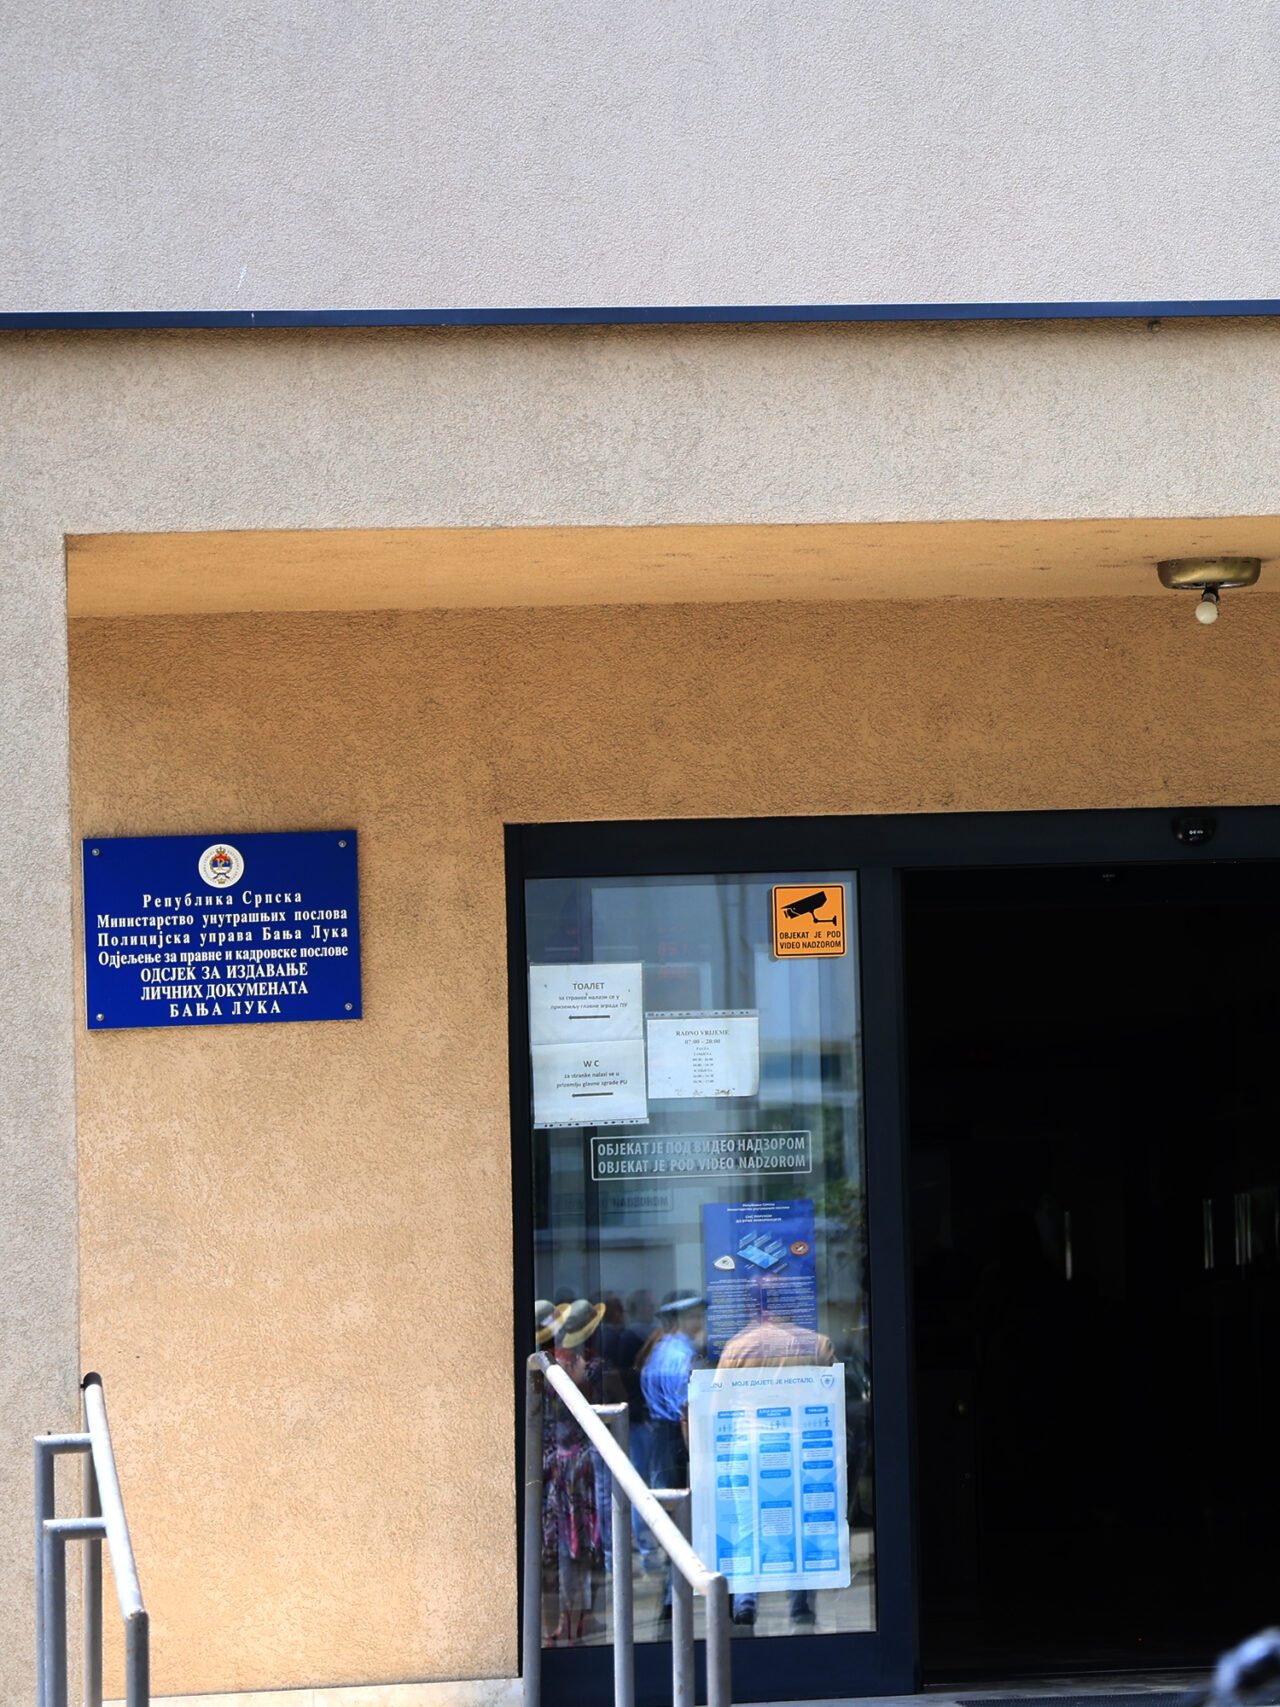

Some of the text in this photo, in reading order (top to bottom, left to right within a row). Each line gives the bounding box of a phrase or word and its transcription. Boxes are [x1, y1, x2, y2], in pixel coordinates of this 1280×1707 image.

[143, 890, 302, 910] Република Српска
[97, 908, 347, 929] Министарство унутрашњих послова
[98, 925, 348, 948] Полицијска управа Бања Лука
[99, 945, 348, 968] Одјељење за правне и кадровске послове
[141, 962, 308, 983] ОДСЈЕК ЗА ИЗДАВАЊЕ
[141, 981, 308, 1000] ЛИЧНИХ ДОКУМЕНАТА
[170, 999, 281, 1017] БАЊА ЛУКА
[598, 1137, 805, 1156] ОБЈЕКАТ ЈЕ ПОД ВИДЕО НАДЗОРОМ
[598, 1155, 805, 1174] OBJEKAT JE POD VIDEO NADZOROM
